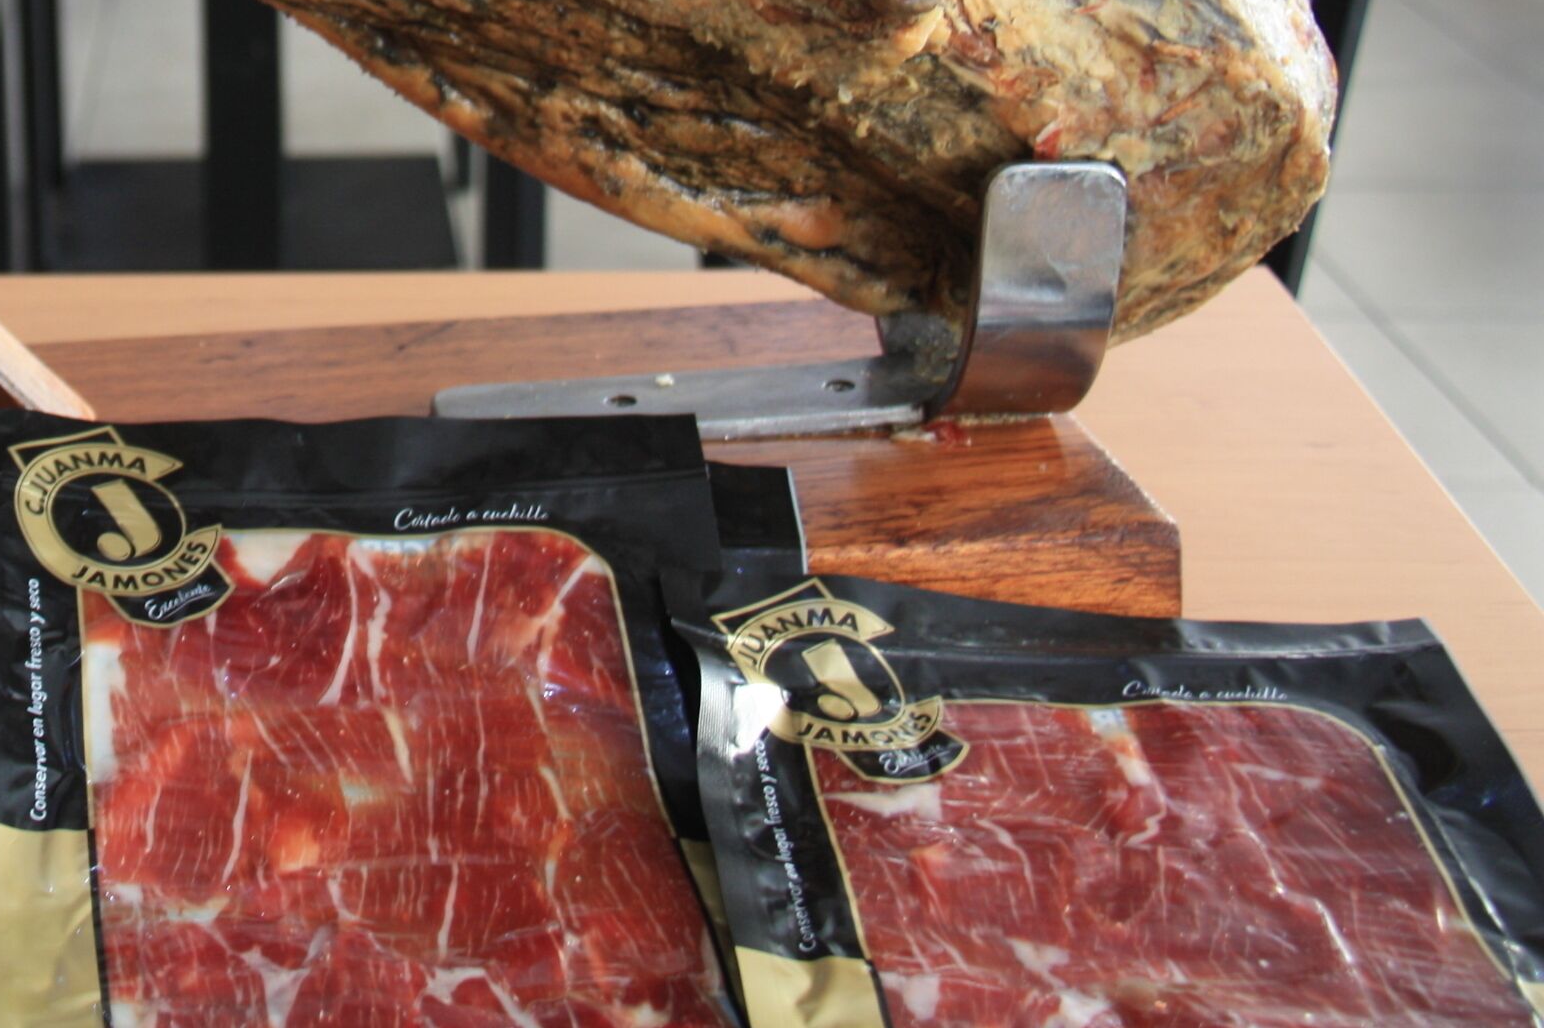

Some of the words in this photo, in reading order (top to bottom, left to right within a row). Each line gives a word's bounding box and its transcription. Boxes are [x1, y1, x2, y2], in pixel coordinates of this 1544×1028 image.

[394, 507, 460, 531] Cortado
[466, 510, 477, 520] a
[482, 503, 549, 520] cuchillo
[72, 540, 208, 590] JAMONES
[28, 578, 40, 610] seco
[30, 611, 46, 625] y
[24, 626, 42, 669] fresco
[26, 672, 48, 715] lugar
[32, 718, 44, 738] en
[29, 739, 47, 821] Conservar
[760, 773, 777, 784] y
[763, 785, 782, 825] fresco
[773, 827, 794, 862] lugar
